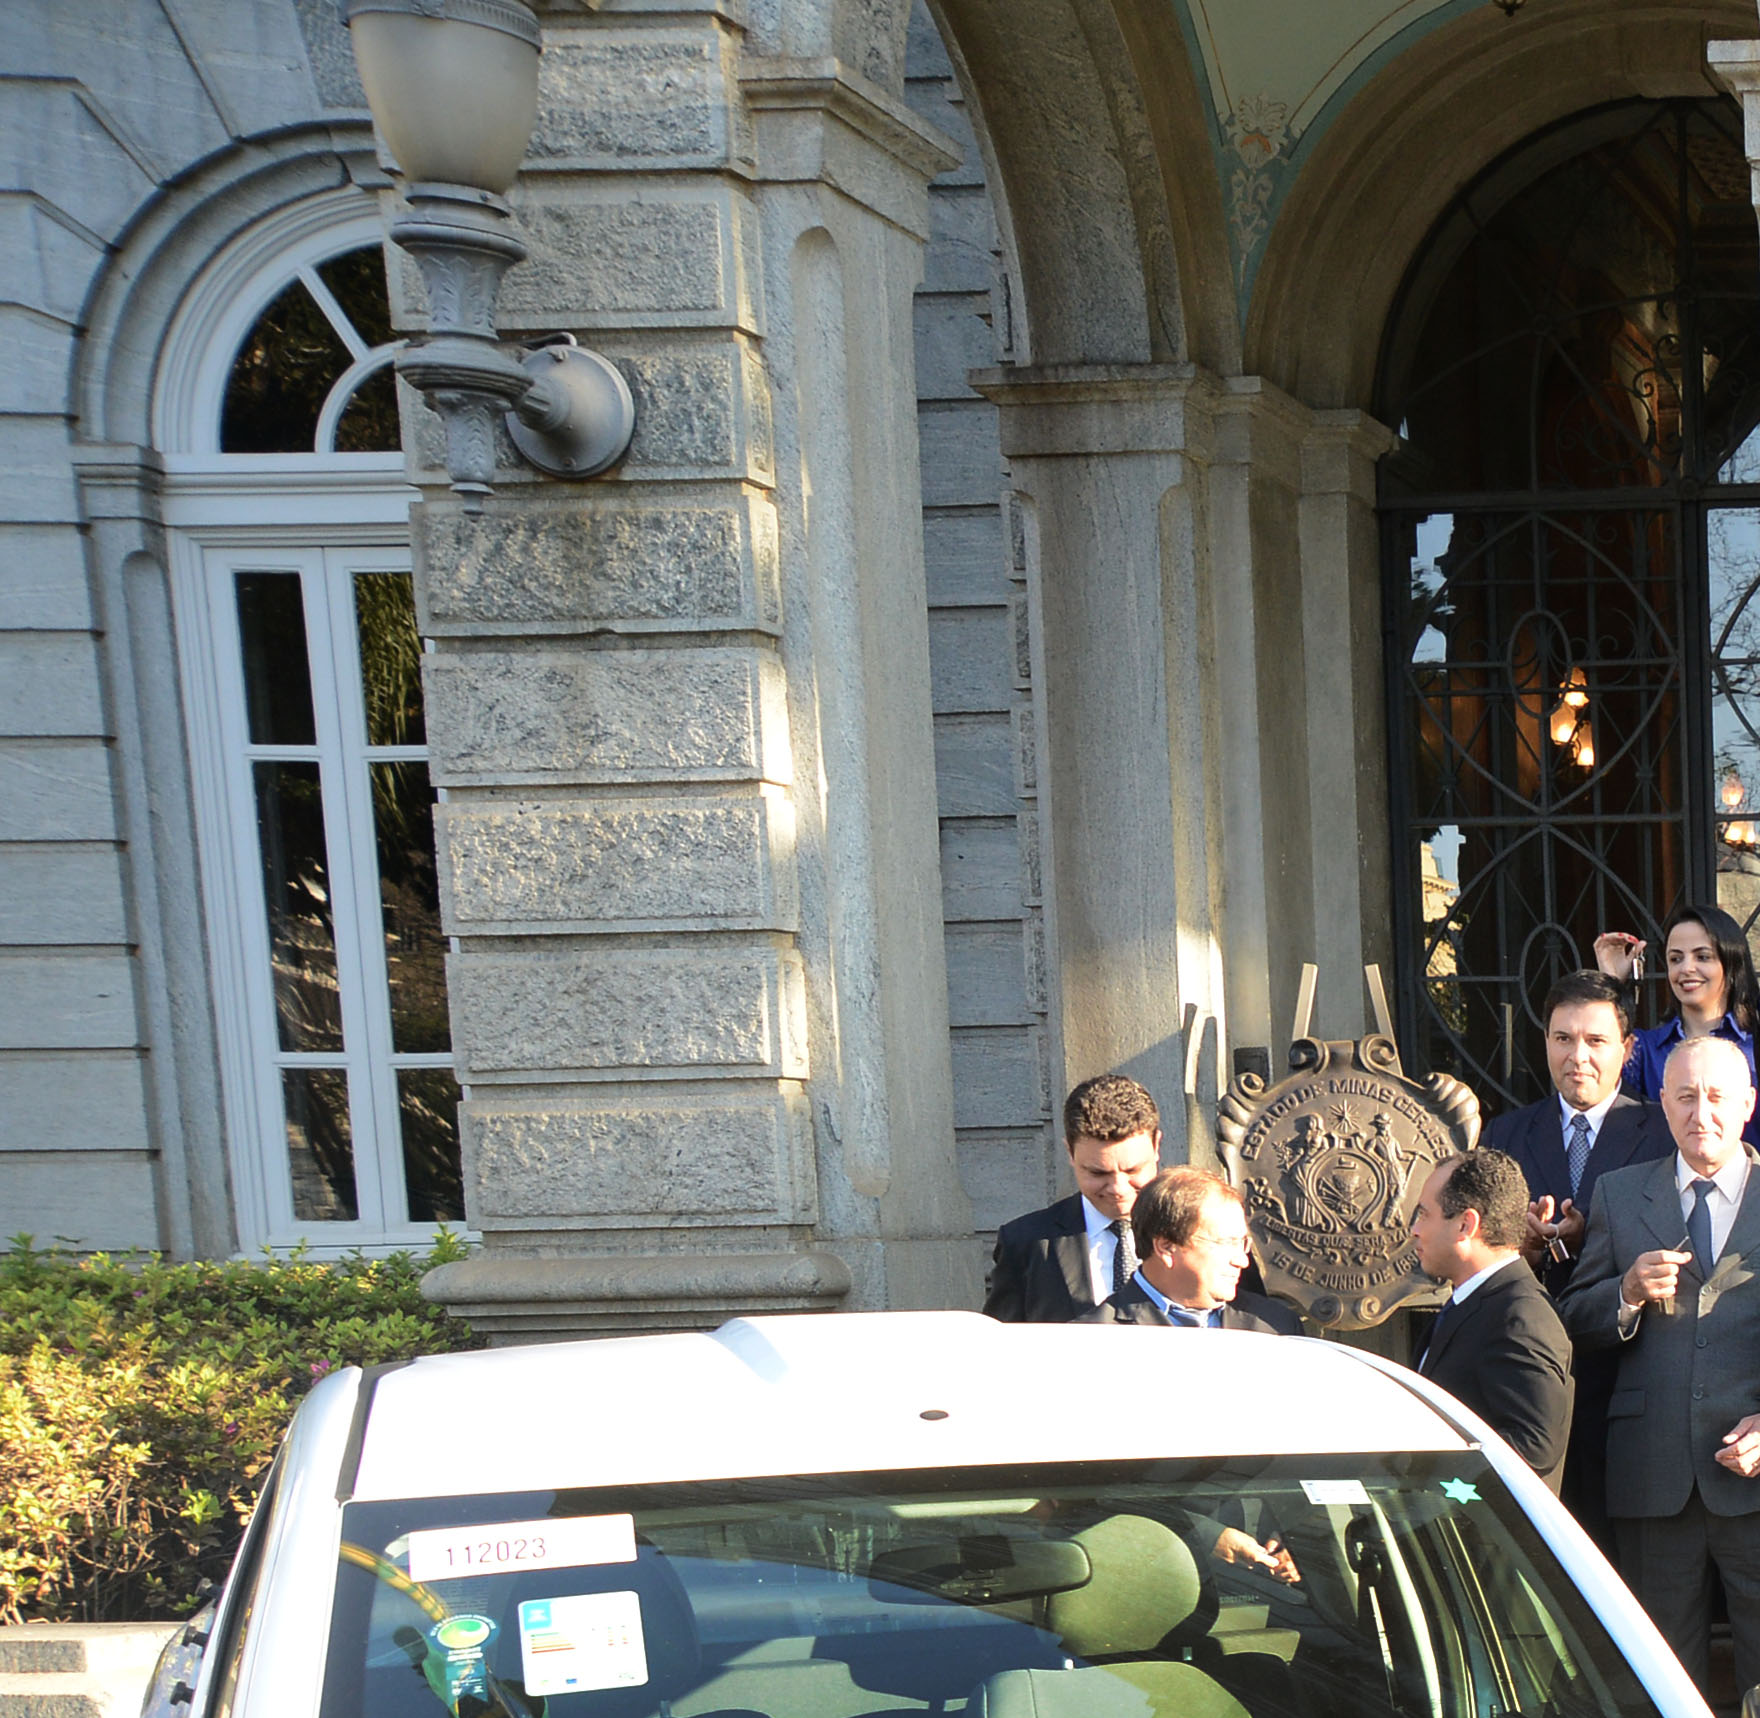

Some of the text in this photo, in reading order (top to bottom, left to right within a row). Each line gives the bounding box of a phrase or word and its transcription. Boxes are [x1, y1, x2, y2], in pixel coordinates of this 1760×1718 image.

[1241, 1078, 1453, 1160] ESTADO DE MINAS GERAES
[1272, 1251, 1294, 1269] 15
[1293, 1262, 1316, 1284] DE
[1319, 1272, 1368, 1290] JUNHO
[1368, 1268, 1396, 1286] DE
[446, 1537, 546, 1566] 112023
